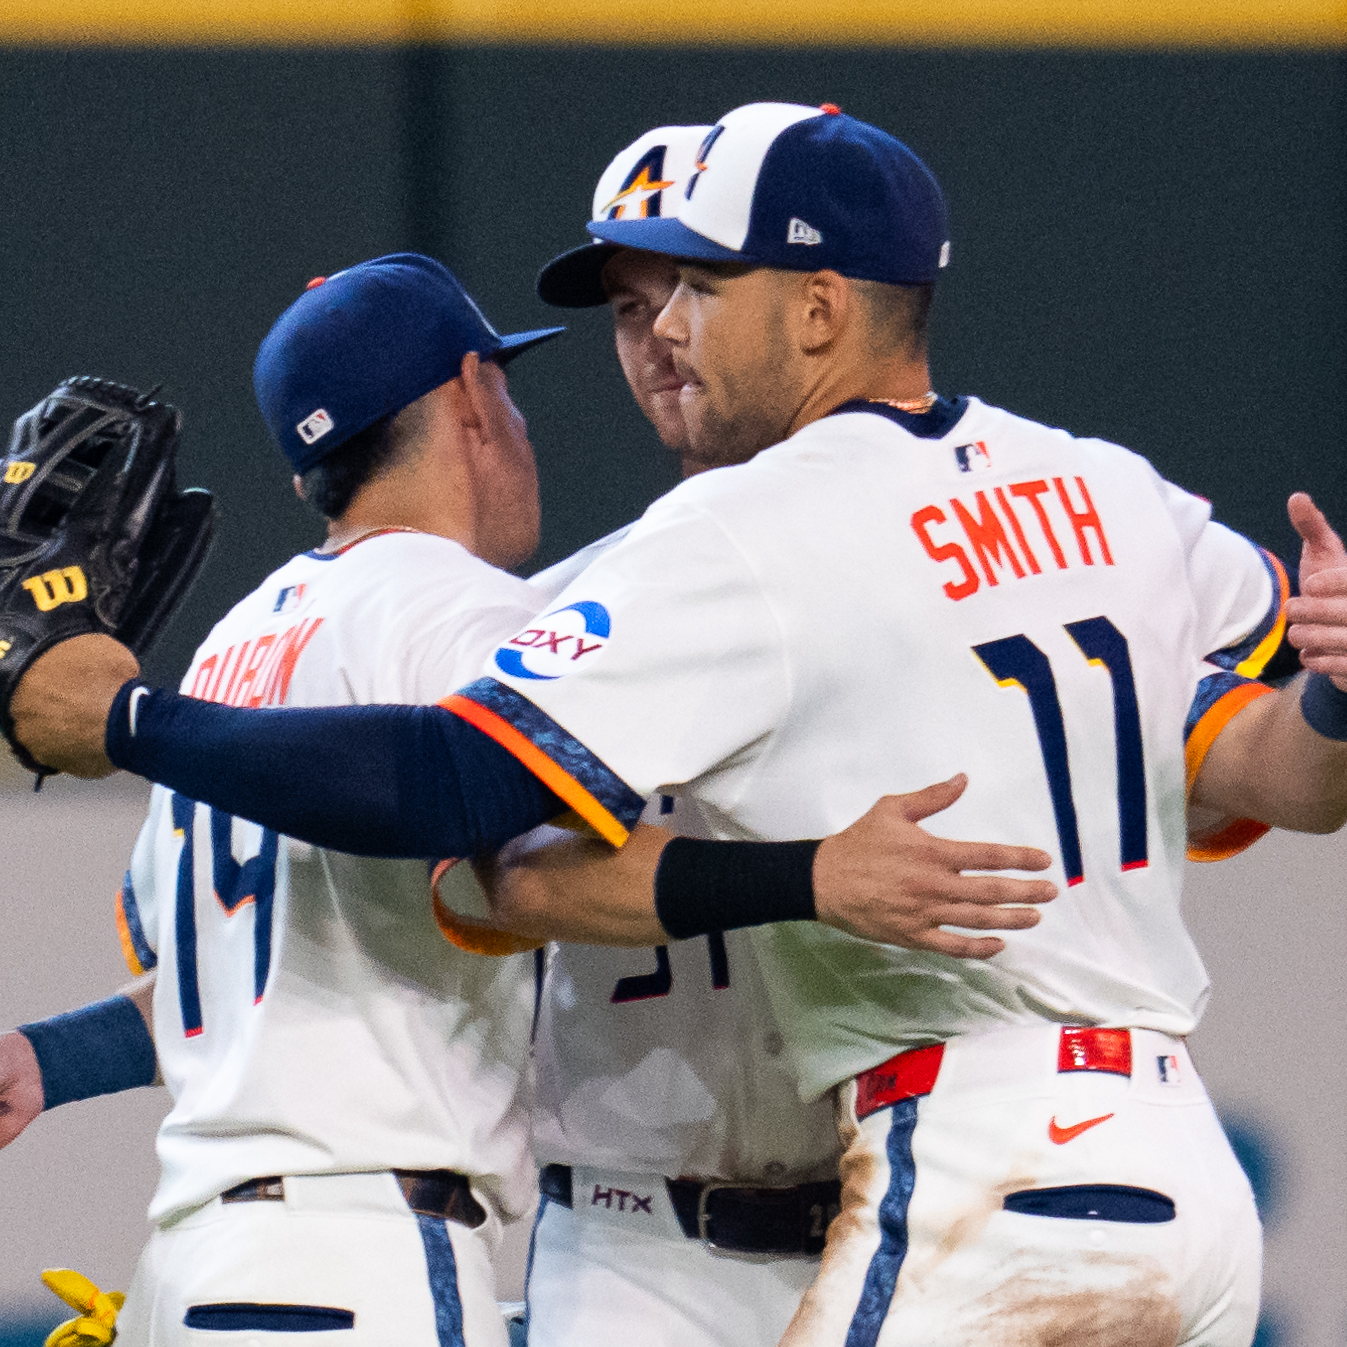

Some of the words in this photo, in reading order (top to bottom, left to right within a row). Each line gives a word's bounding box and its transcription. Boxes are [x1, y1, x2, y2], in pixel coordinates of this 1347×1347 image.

[910, 475, 1116, 602] SMITH
[509, 629, 603, 661] OXY
[969, 614, 1149, 888] 11
[591, 1184, 653, 1214] HTX
